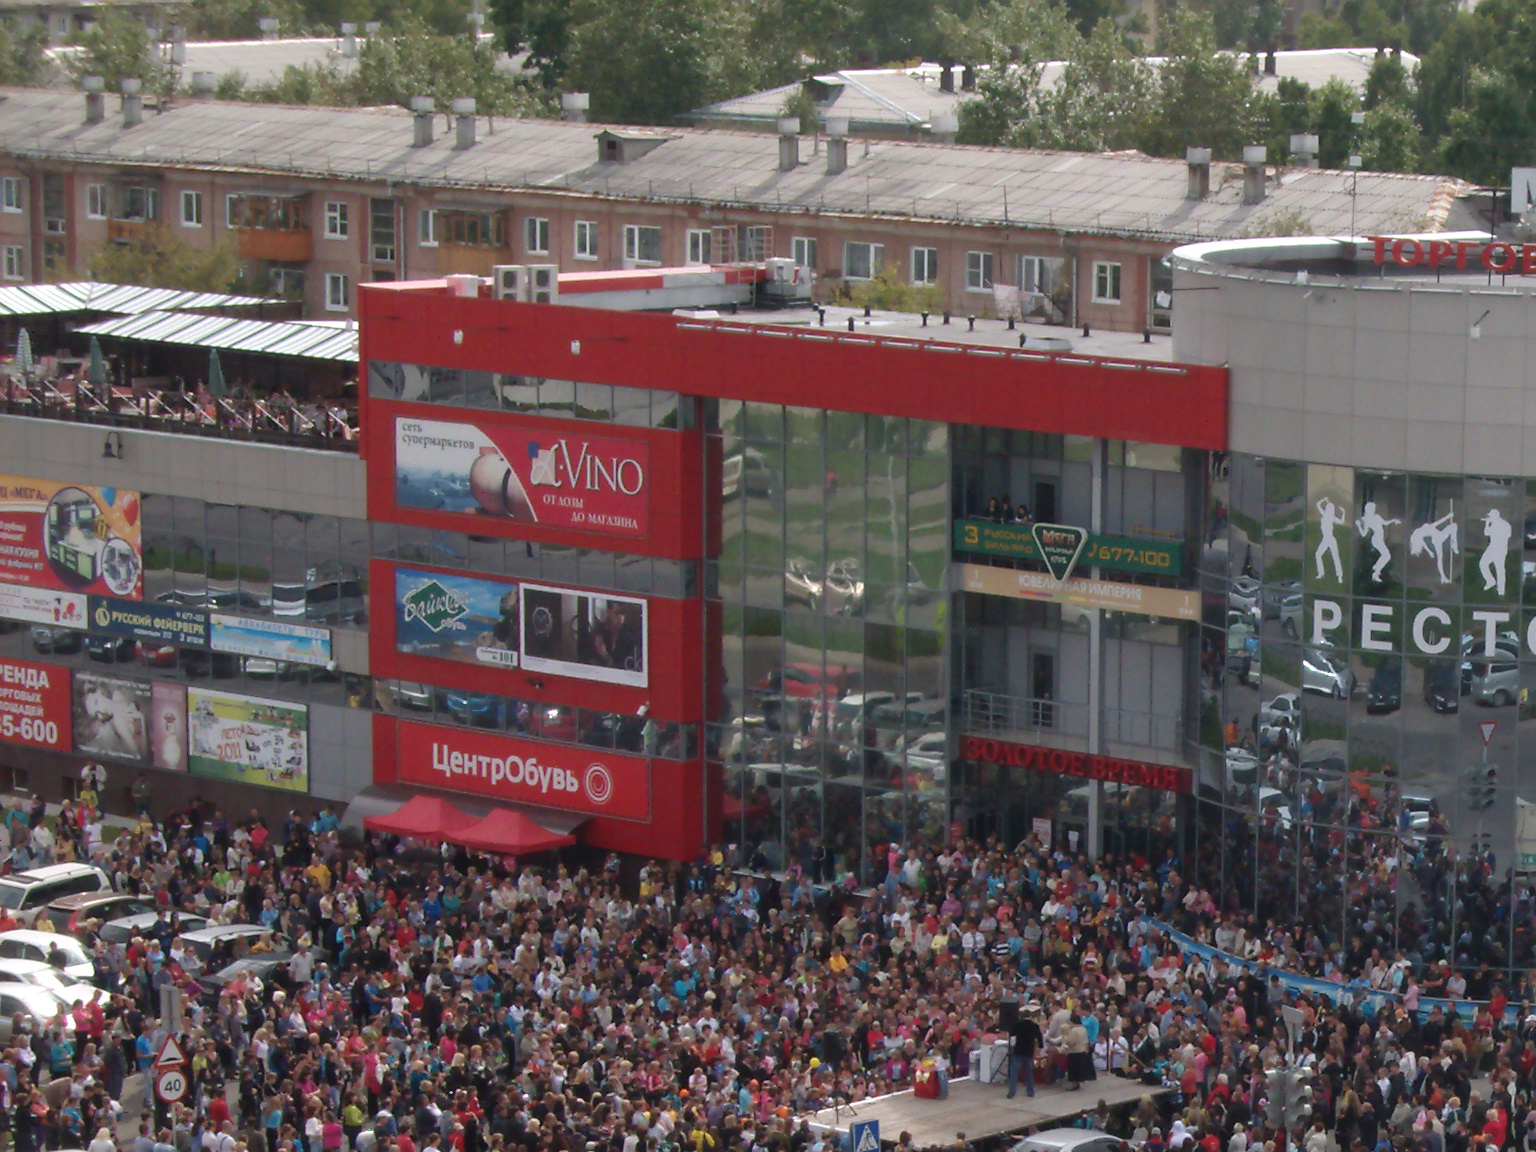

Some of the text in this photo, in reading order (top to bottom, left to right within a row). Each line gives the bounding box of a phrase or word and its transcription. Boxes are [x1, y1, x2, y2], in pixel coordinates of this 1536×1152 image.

[402, 423, 423, 433] сеть
[402, 434, 475, 450] супермаркетов
[559, 496, 584, 510] ЛОЗЫ
[588, 514, 639, 530] МАГАЗИНА
[964, 525, 979, 544] 3
[1089, 583, 1142, 601] ИМПЕРИЯ
[112, 611, 153, 627] РУССКИЙ
[153, 618, 205, 636] ФЕЙЕРВЕРК
[0, 714, 59, 744] 5-600
[216, 741, 243, 760] 2011
[432, 742, 579, 793] ЦентрОбувь
[966, 737, 1179, 791] ЗОЛОТОЕ ВРЕМЯ
[164, 1079, 181, 1092] 40
